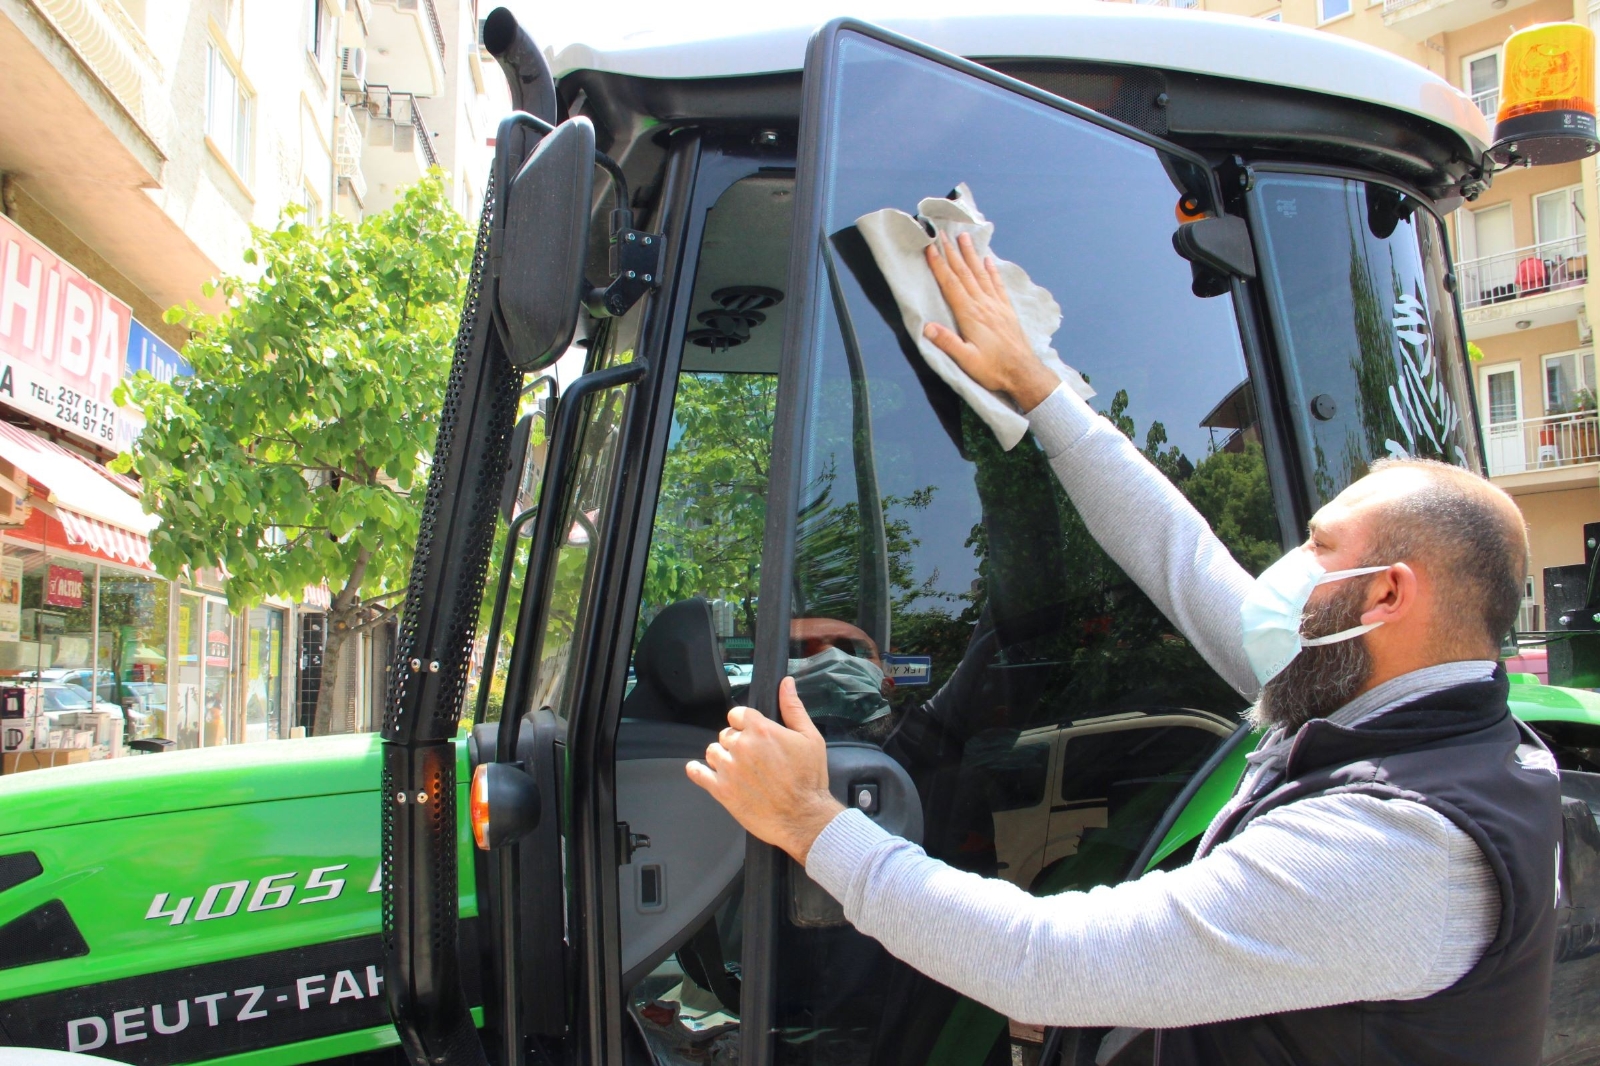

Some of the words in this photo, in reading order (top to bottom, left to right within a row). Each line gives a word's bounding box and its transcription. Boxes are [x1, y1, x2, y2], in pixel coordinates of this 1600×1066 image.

[30, 382, 54, 405] TEL:
[58, 386, 82, 408] 237
[84, 399, 98, 417] 61
[102, 407, 115, 425] 71
[56, 403, 79, 425] 234
[82, 416, 97, 433] 97
[100, 424, 114, 441] 56
[57, 578, 82, 599] ALTUS
[144, 863, 349, 926] 4065
